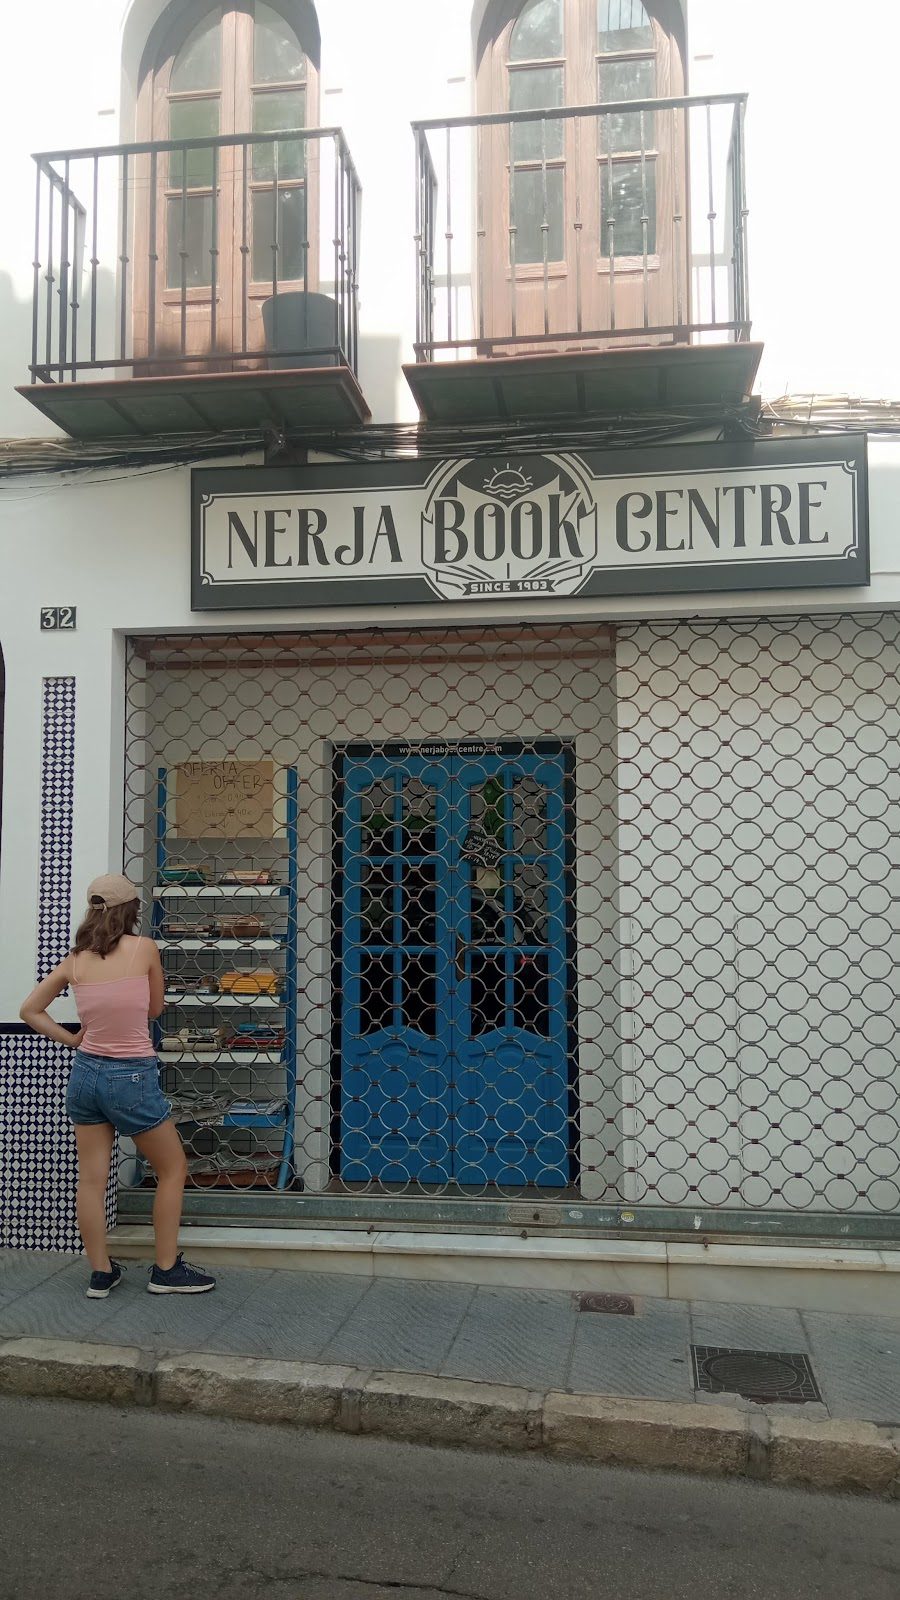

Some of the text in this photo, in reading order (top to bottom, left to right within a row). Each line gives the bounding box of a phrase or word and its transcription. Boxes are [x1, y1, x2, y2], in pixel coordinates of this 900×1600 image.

[227, 481, 829, 569] NERJA BOOK CENTRE
[470, 582, 511, 593] SINCE
[41, 607, 74, 629] 32
